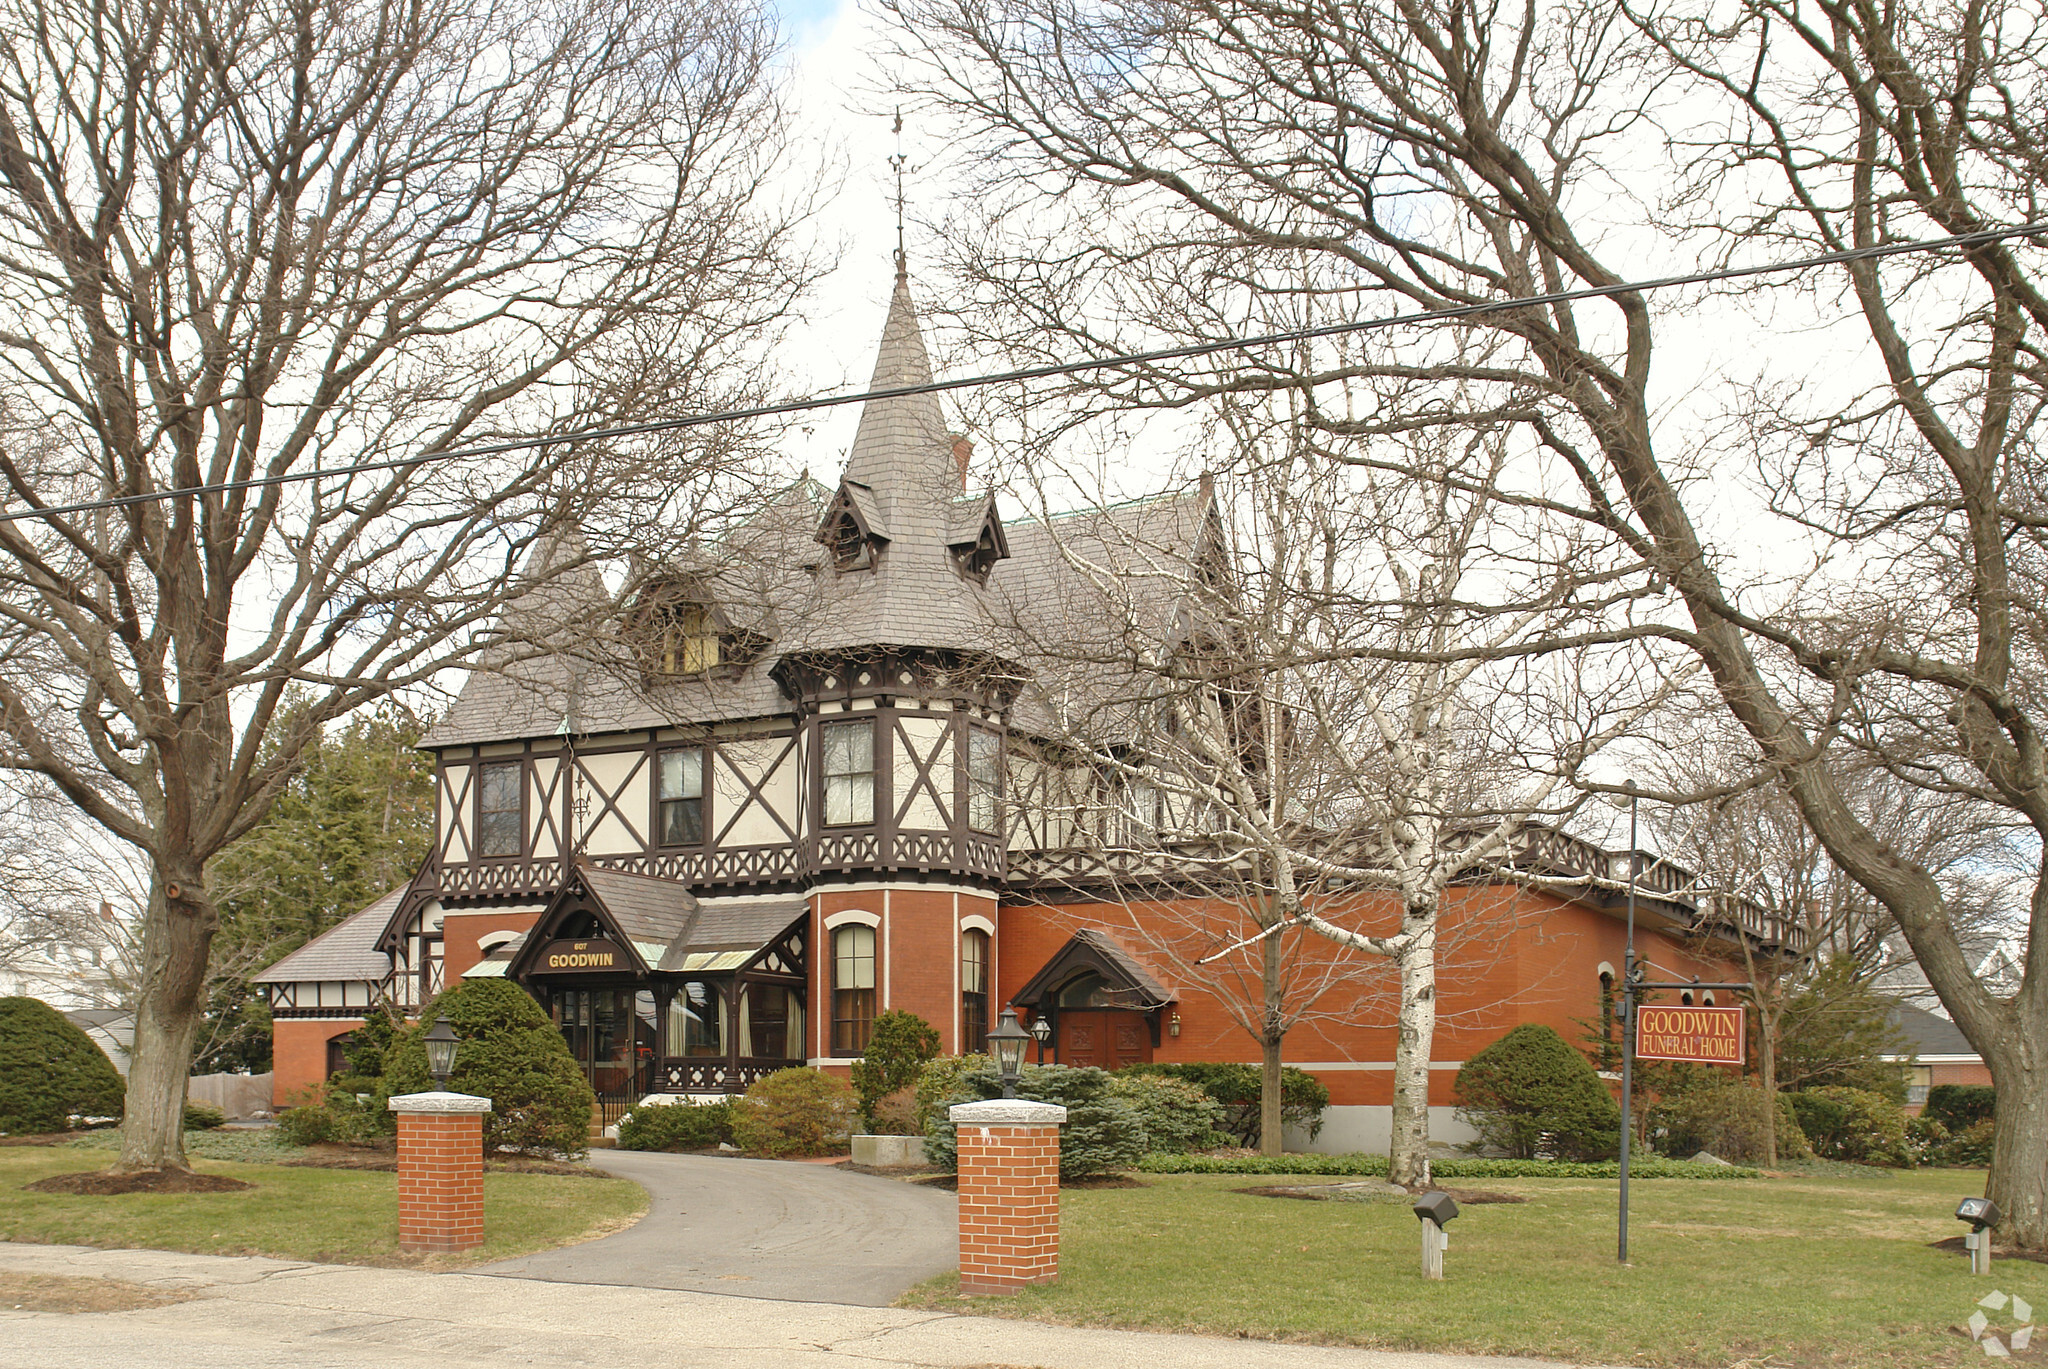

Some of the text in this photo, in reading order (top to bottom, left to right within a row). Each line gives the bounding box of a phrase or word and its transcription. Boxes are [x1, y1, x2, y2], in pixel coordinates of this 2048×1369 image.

[549, 953, 613, 967] GOODWIN
[1642, 1011, 1737, 1036] GOODWIN
[1642, 1034, 1736, 1058] FUNERAL HOME
